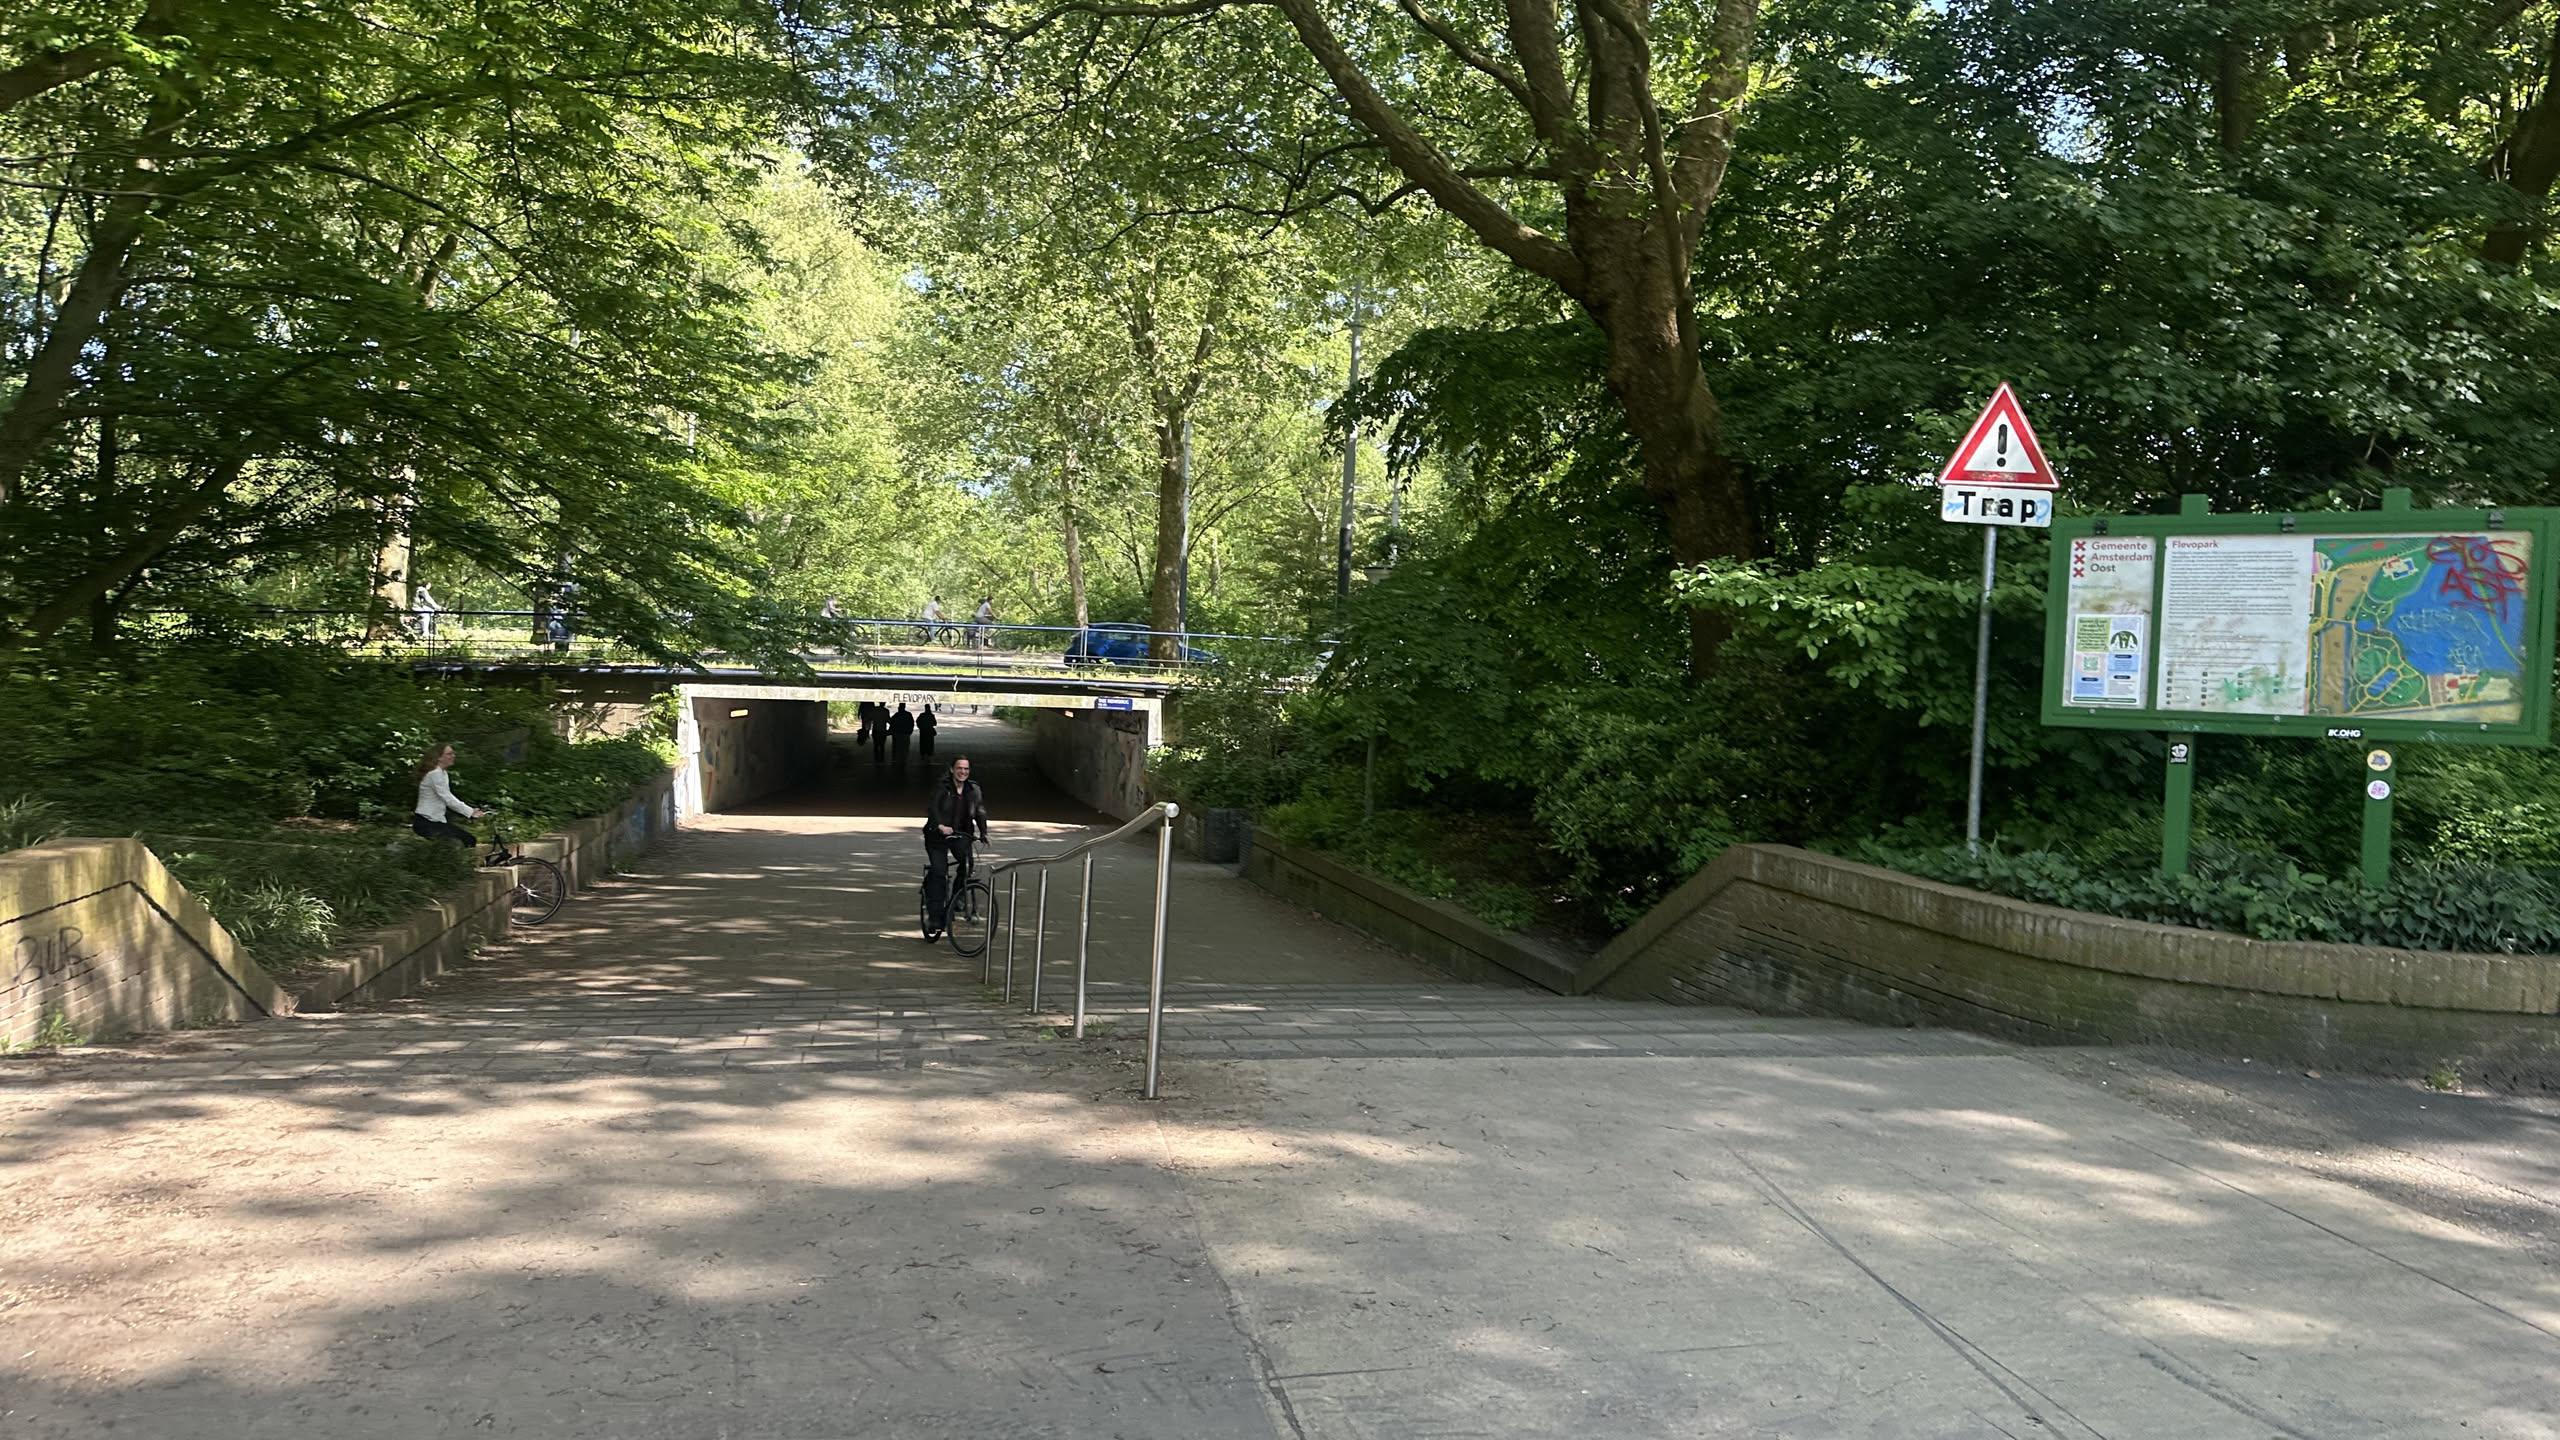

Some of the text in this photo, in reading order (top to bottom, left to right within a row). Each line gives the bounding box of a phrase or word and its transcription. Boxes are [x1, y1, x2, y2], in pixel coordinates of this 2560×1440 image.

[1957, 490, 2037, 523] Trap
[2091, 541, 2148, 551] Gemeente
[2172, 540, 2219, 549] Flevopark
[2091, 552, 2153, 561] Amsterdam
[2090, 563, 2116, 573] Oost
[893, 693, 936, 703] FLEVOPARK
